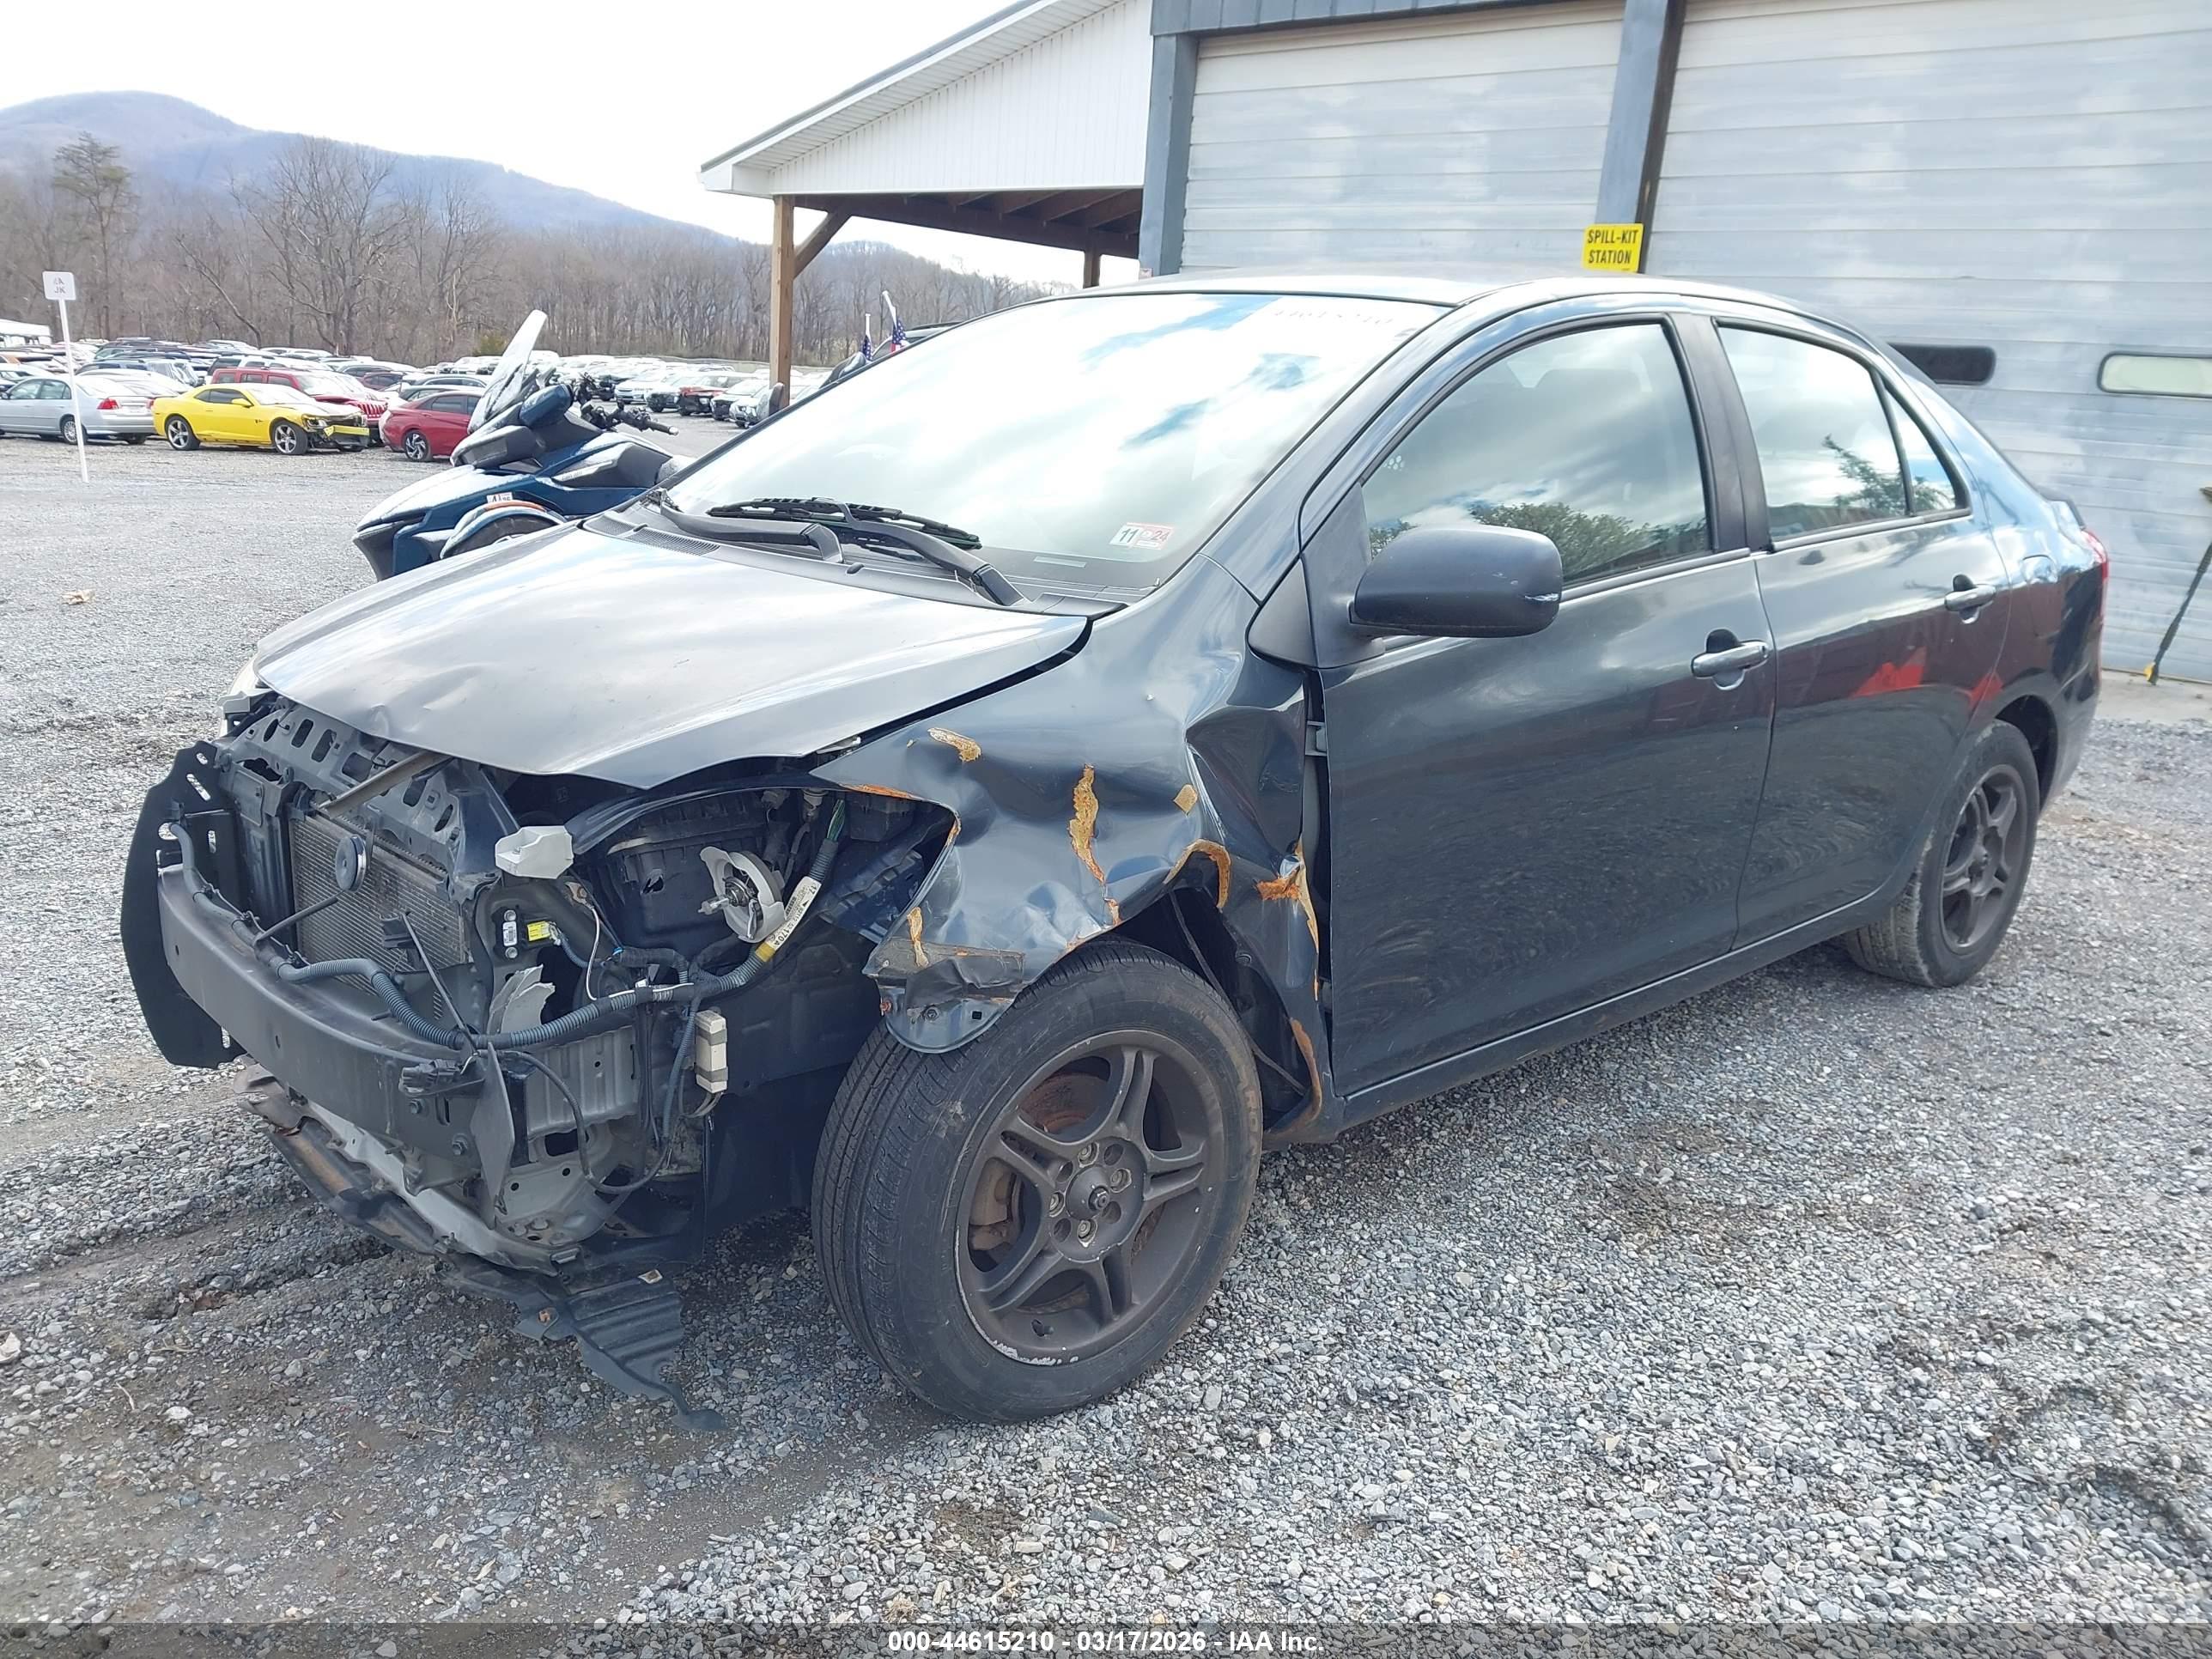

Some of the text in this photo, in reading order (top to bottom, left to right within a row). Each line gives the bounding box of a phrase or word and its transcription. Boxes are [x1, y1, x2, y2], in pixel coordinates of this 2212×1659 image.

[1588, 228, 1638, 244] SPILL-KIT
[1589, 249, 1632, 264] STATION
[1119, 528, 1139, 544] 11
